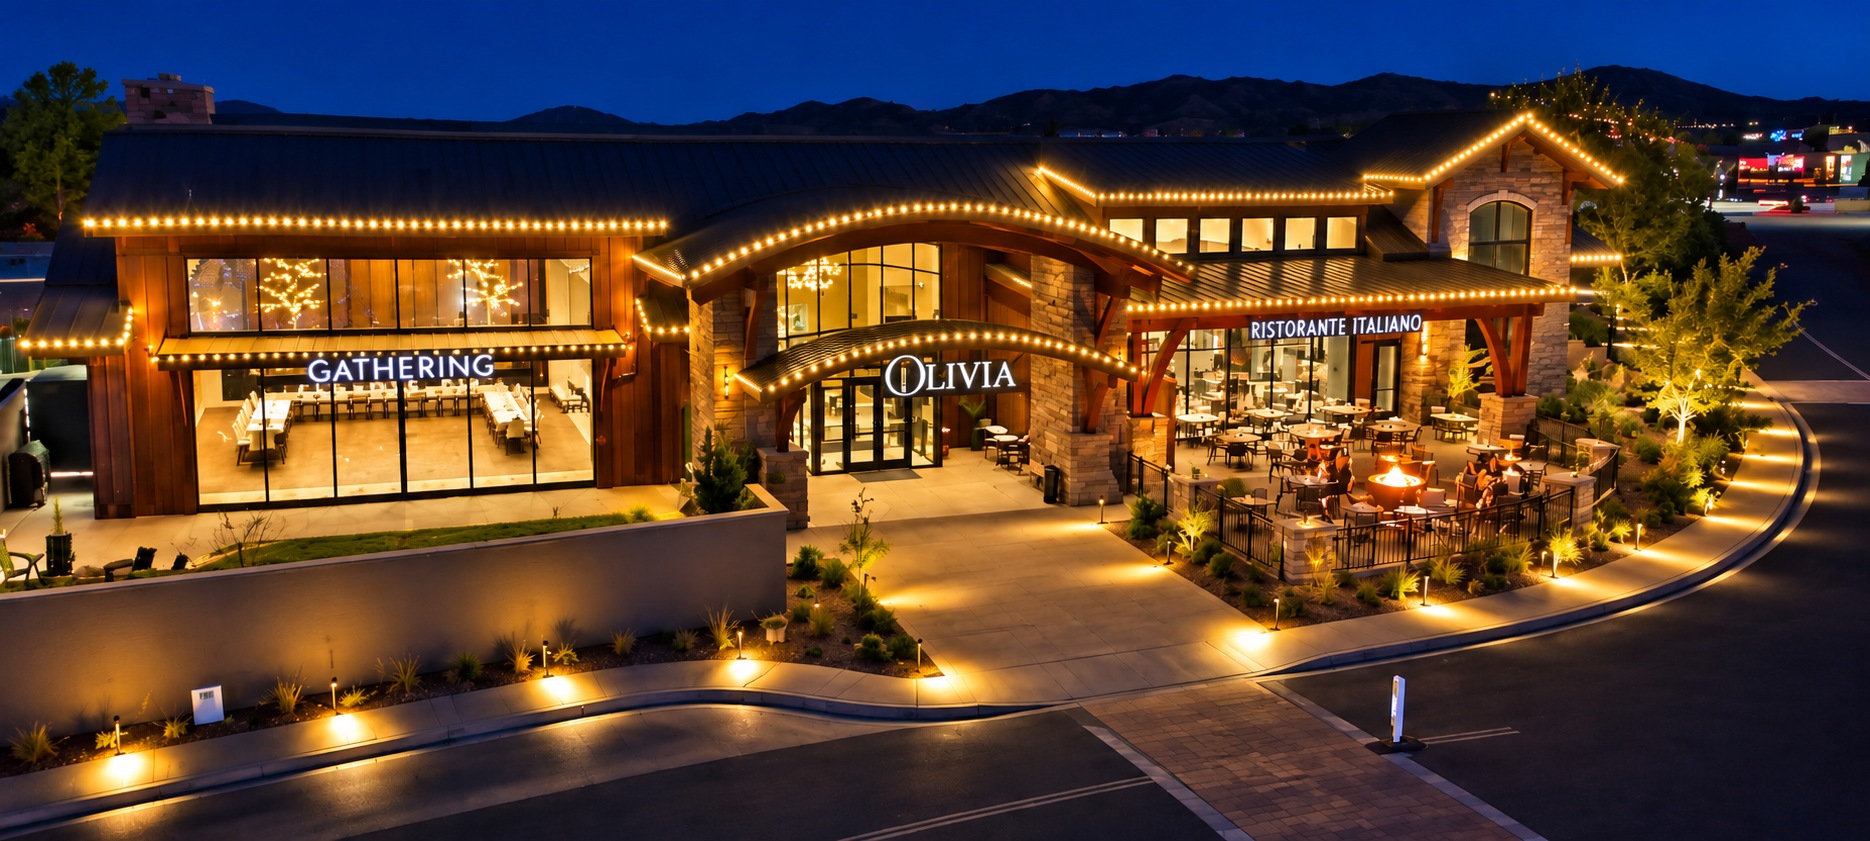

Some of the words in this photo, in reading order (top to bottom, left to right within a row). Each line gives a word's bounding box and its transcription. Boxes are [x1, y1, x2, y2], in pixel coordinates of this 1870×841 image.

[1251, 318, 1346, 339] RISTORANTE
[1352, 314, 1422, 334] ITALIANO
[307, 354, 494, 382] GATHERING
[885, 354, 1016, 396] OLIVIA
